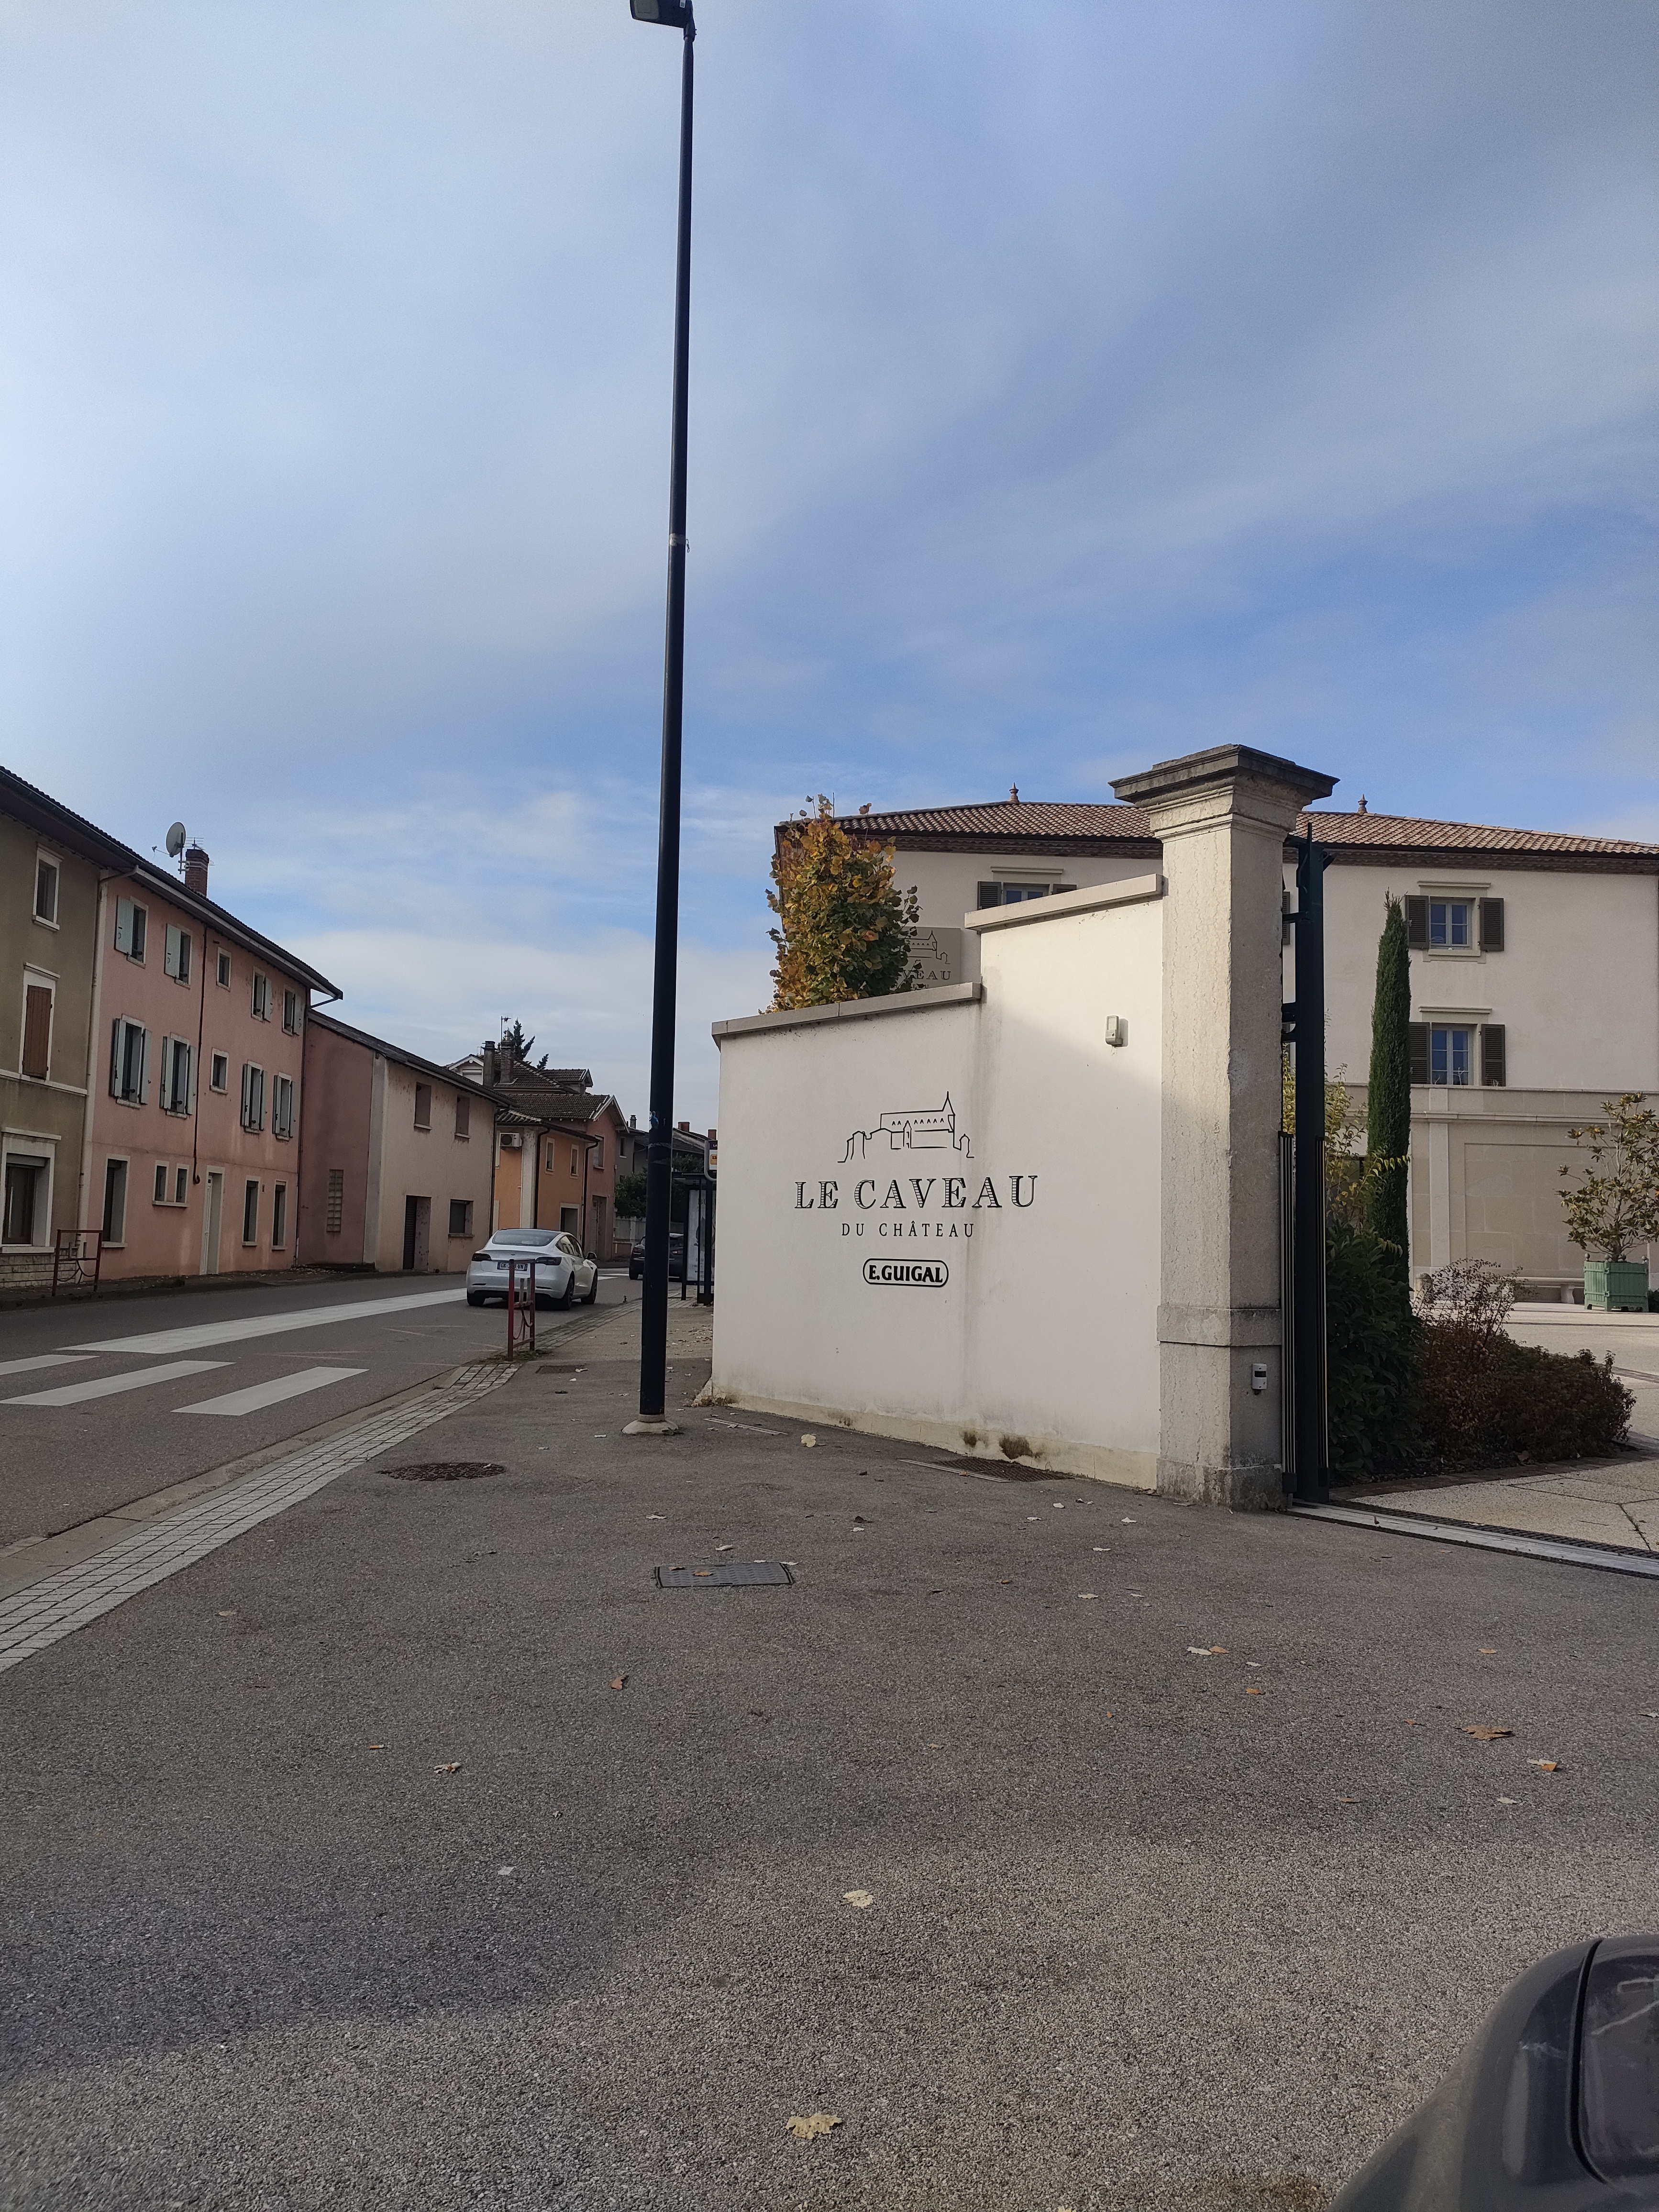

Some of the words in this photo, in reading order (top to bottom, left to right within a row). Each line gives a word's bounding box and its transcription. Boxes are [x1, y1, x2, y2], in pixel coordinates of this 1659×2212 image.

[903, 970, 951, 980] VEAU
[794, 1181, 839, 1209] LE
[854, 1175, 1038, 1210] CAVEAU
[841, 1223, 865, 1237] DU
[878, 1220, 974, 1238] CHÂTEAU
[869, 1264, 943, 1283] E.GUIGAL
